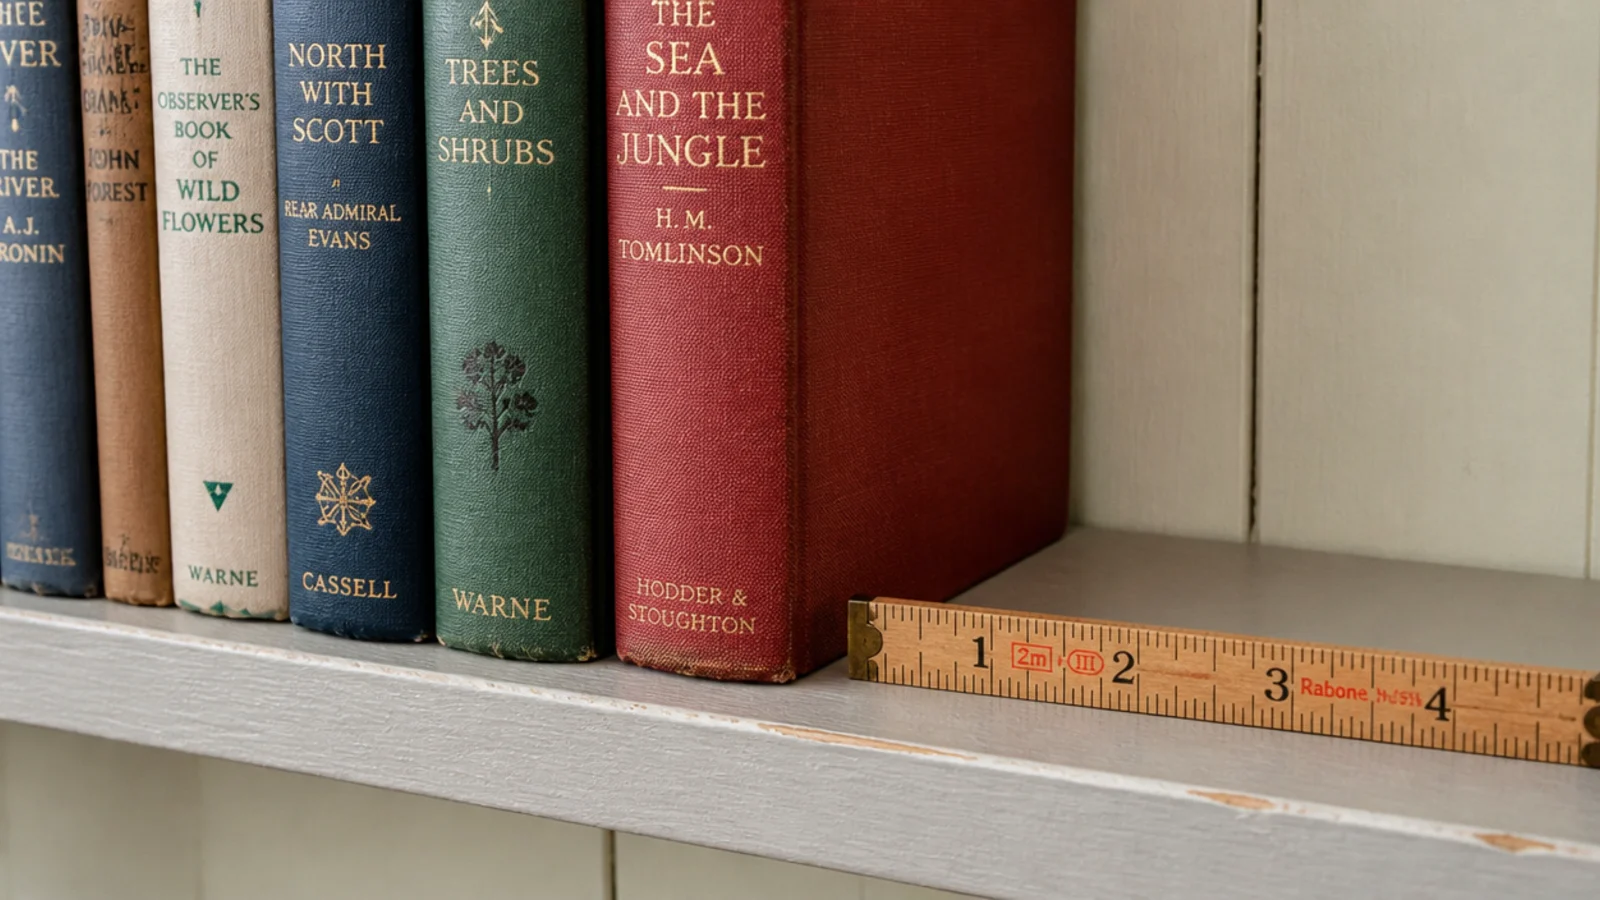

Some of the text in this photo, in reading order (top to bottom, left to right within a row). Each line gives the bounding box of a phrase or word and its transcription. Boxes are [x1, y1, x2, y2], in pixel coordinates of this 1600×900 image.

[651, 0, 716, 28] THE
[180, 57, 222, 76] THE
[288, 42, 387, 70] NORTH
[645, 41, 726, 76] SEA
[445, 58, 541, 88] TREES
[157, 92, 261, 111] OBSERVER'S
[300, 80, 374, 107] WITH
[616, 89, 767, 121] AND THE
[459, 99, 524, 126] AND
[174, 120, 233, 140] BOOK
[292, 118, 385, 145] SCOTT
[0, 149, 39, 171] THE
[192, 150, 219, 169] OF
[437, 136, 555, 166] SHRUBS
[616, 132, 767, 169] JUNGLE
[176, 178, 241, 202] WILD
[162, 210, 265, 234] FLOWERS
[284, 200, 402, 222] REAR ADMIRAL
[2, 215, 40, 236] A.J.
[307, 228, 371, 251] EVANS
[618, 238, 764, 267] TOMLINSON
[188, 563, 259, 588] WARNE
[302, 571, 398, 600] CASSELL
[452, 587, 553, 622] WARNE
[637, 577, 749, 608] HODDER &
[628, 603, 757, 636] STOUGHTON
[971, 635, 990, 670] 1
[1017, 647, 1047, 668] 2m
[1111, 650, 1136, 686] 2
[1263, 667, 1290, 703] 3
[1300, 676, 1369, 702] Rabone
[1424, 686, 1452, 723] 4
